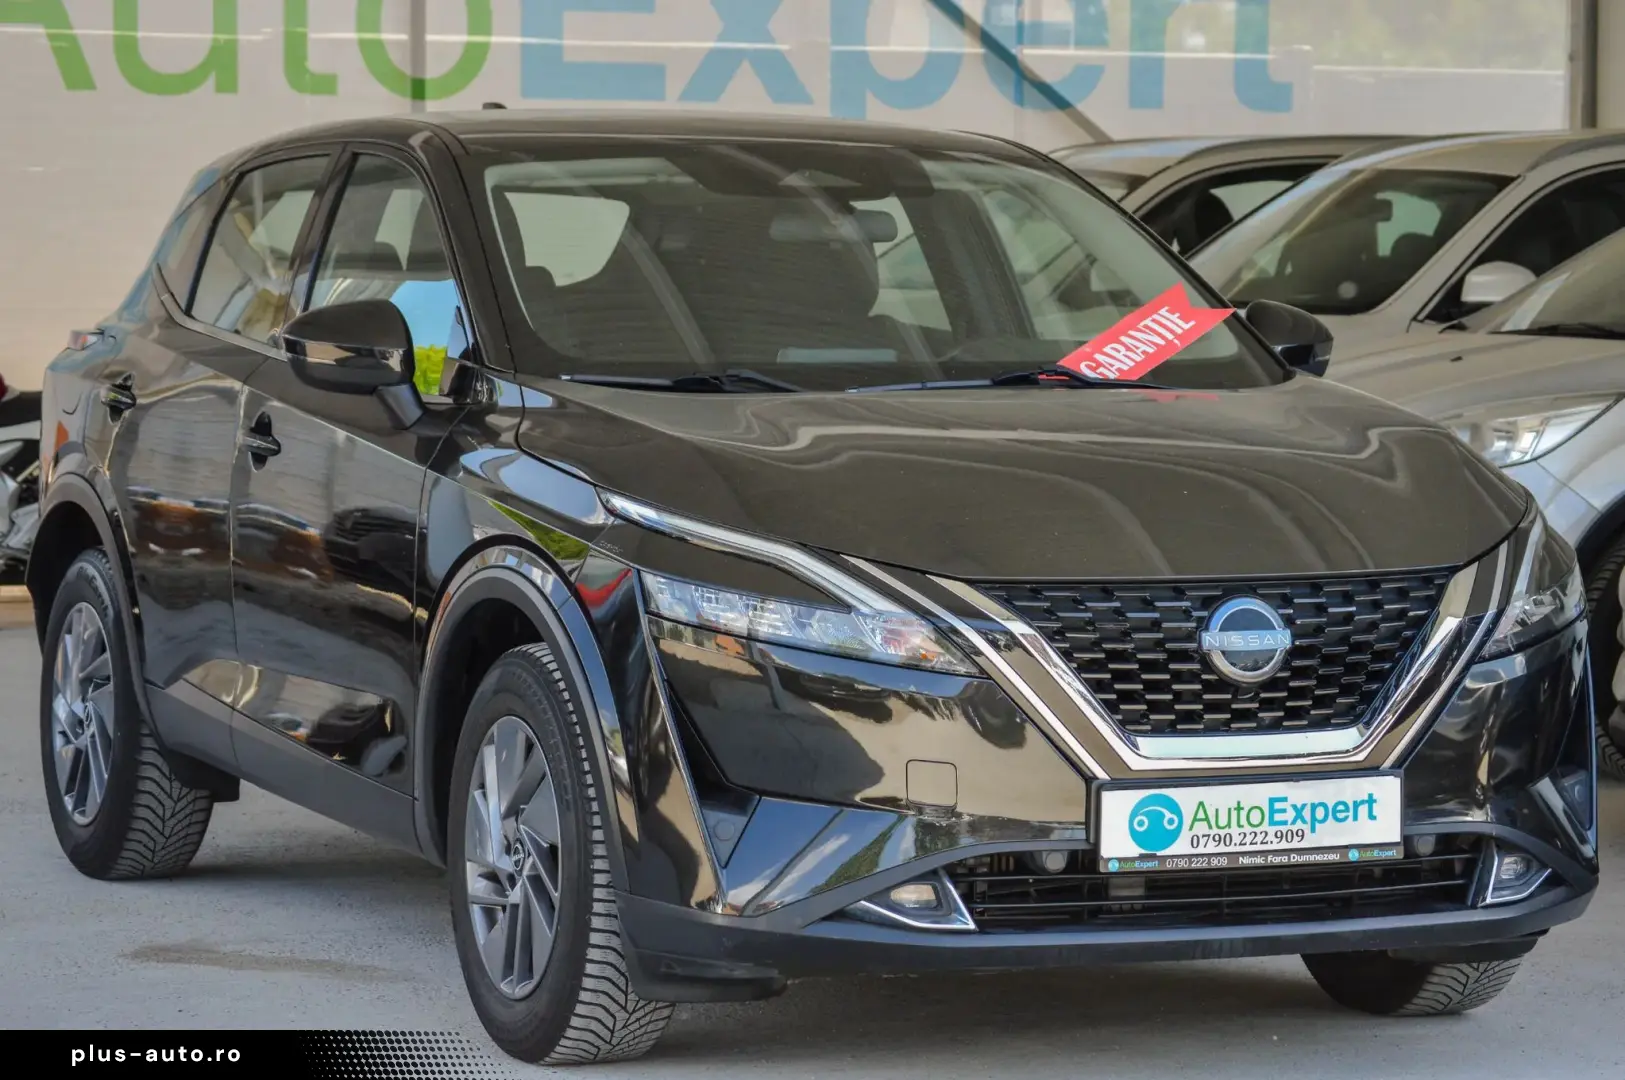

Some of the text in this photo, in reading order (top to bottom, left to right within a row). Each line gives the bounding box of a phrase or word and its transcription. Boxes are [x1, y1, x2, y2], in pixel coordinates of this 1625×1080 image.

[1205, 634, 1289, 647] NISSAN
[1189, 793, 1377, 833] AutoExpert
[1190, 829, 1305, 849] 0790.222.909
[1120, 849, 1397, 869] AutoExpert 0790 222 909 Nimic Fara Dumnezeu AutoExpert
